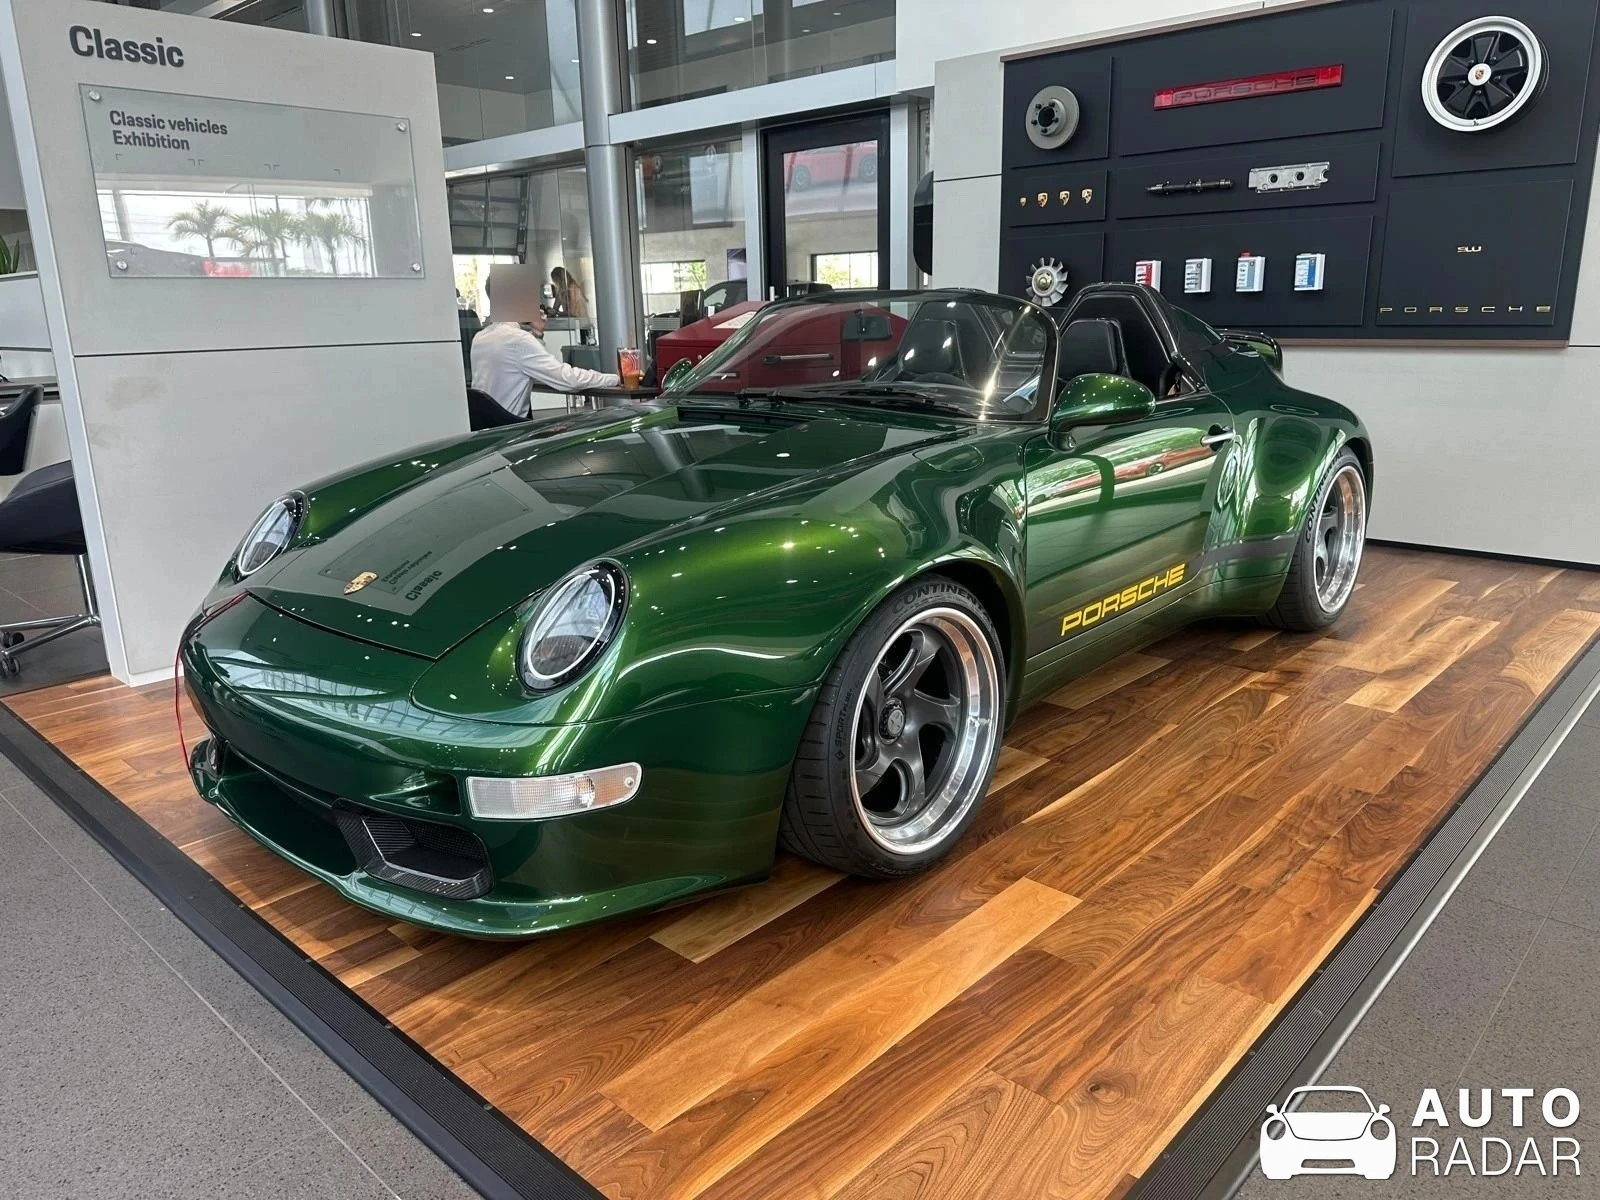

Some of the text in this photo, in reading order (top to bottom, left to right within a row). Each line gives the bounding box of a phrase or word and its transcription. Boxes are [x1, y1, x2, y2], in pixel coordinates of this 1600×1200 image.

[69, 25, 184, 68] Classic
[1173, 74, 1318, 104] PORSCHE
[109, 110, 228, 135] Classic vehicles
[112, 130, 190, 150] Exhibition
[1380, 305, 1551, 314] PORSCHE
[1061, 563, 1186, 637] PORSCHE
